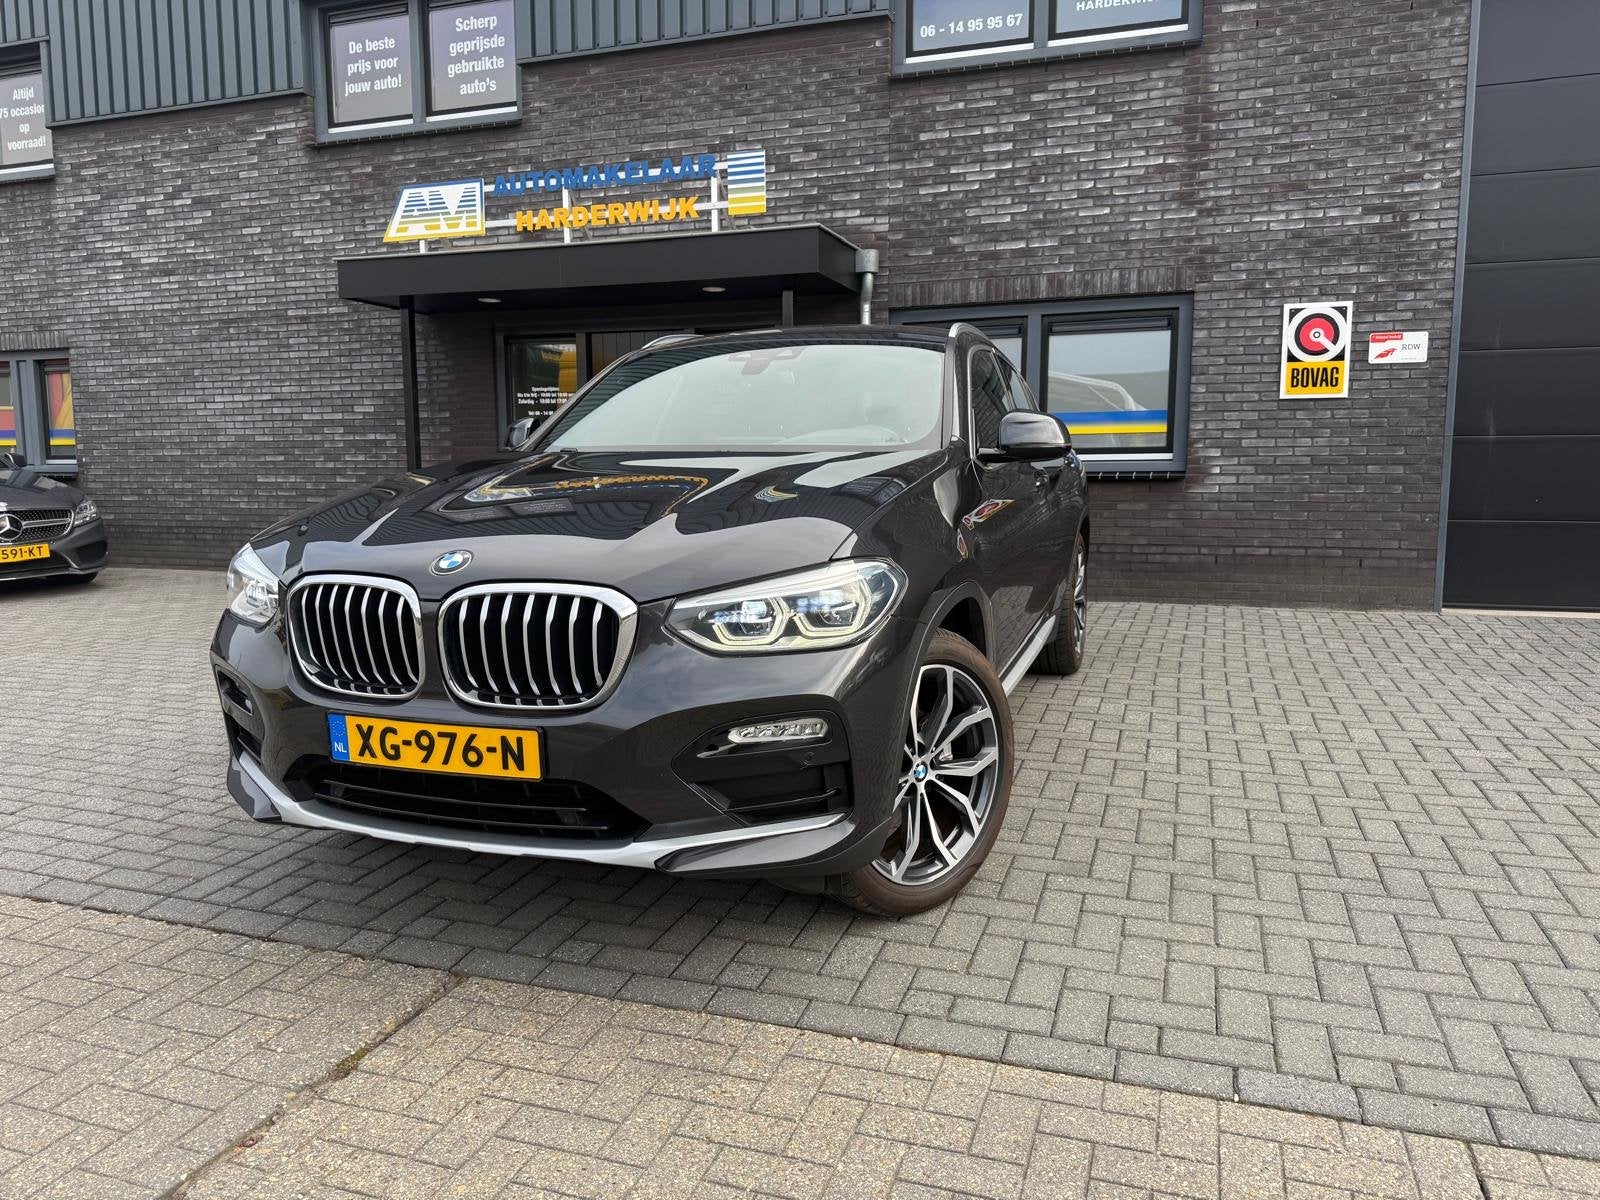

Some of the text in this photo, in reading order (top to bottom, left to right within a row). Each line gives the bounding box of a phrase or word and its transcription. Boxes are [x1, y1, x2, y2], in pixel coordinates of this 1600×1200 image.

[1076, 0, 1157, 11] HARDE
[455, 15, 498, 32] Scherp
[920, 25, 936, 38] 06
[949, 21, 964, 34] 14
[967, 19, 983, 32] 95
[987, 16, 1003, 29] 95
[1006, 13, 1023, 27] 67
[349, 36, 395, 54] De beste
[449, 34, 505, 56] geprijsde
[347, 57, 399, 76] prijs voor
[447, 57, 505, 77] gebruikte
[13, 87, 34, 100] Altijd
[345, 74, 402, 97] jouw auto!
[459, 77, 497, 95] auto's
[19, 123, 30, 134] op
[7, 136, 47, 151] voorraad!
[492, 154, 716, 197] AUTOMAKELAAR
[516, 196, 700, 232] HARDERWIJK
[1401, 343, 1421, 351] RDW
[1290, 366, 1339, 388] BOVAG
[1, 546, 43, 560] 591-KT
[334, 723, 525, 771] NL XG-976-N
